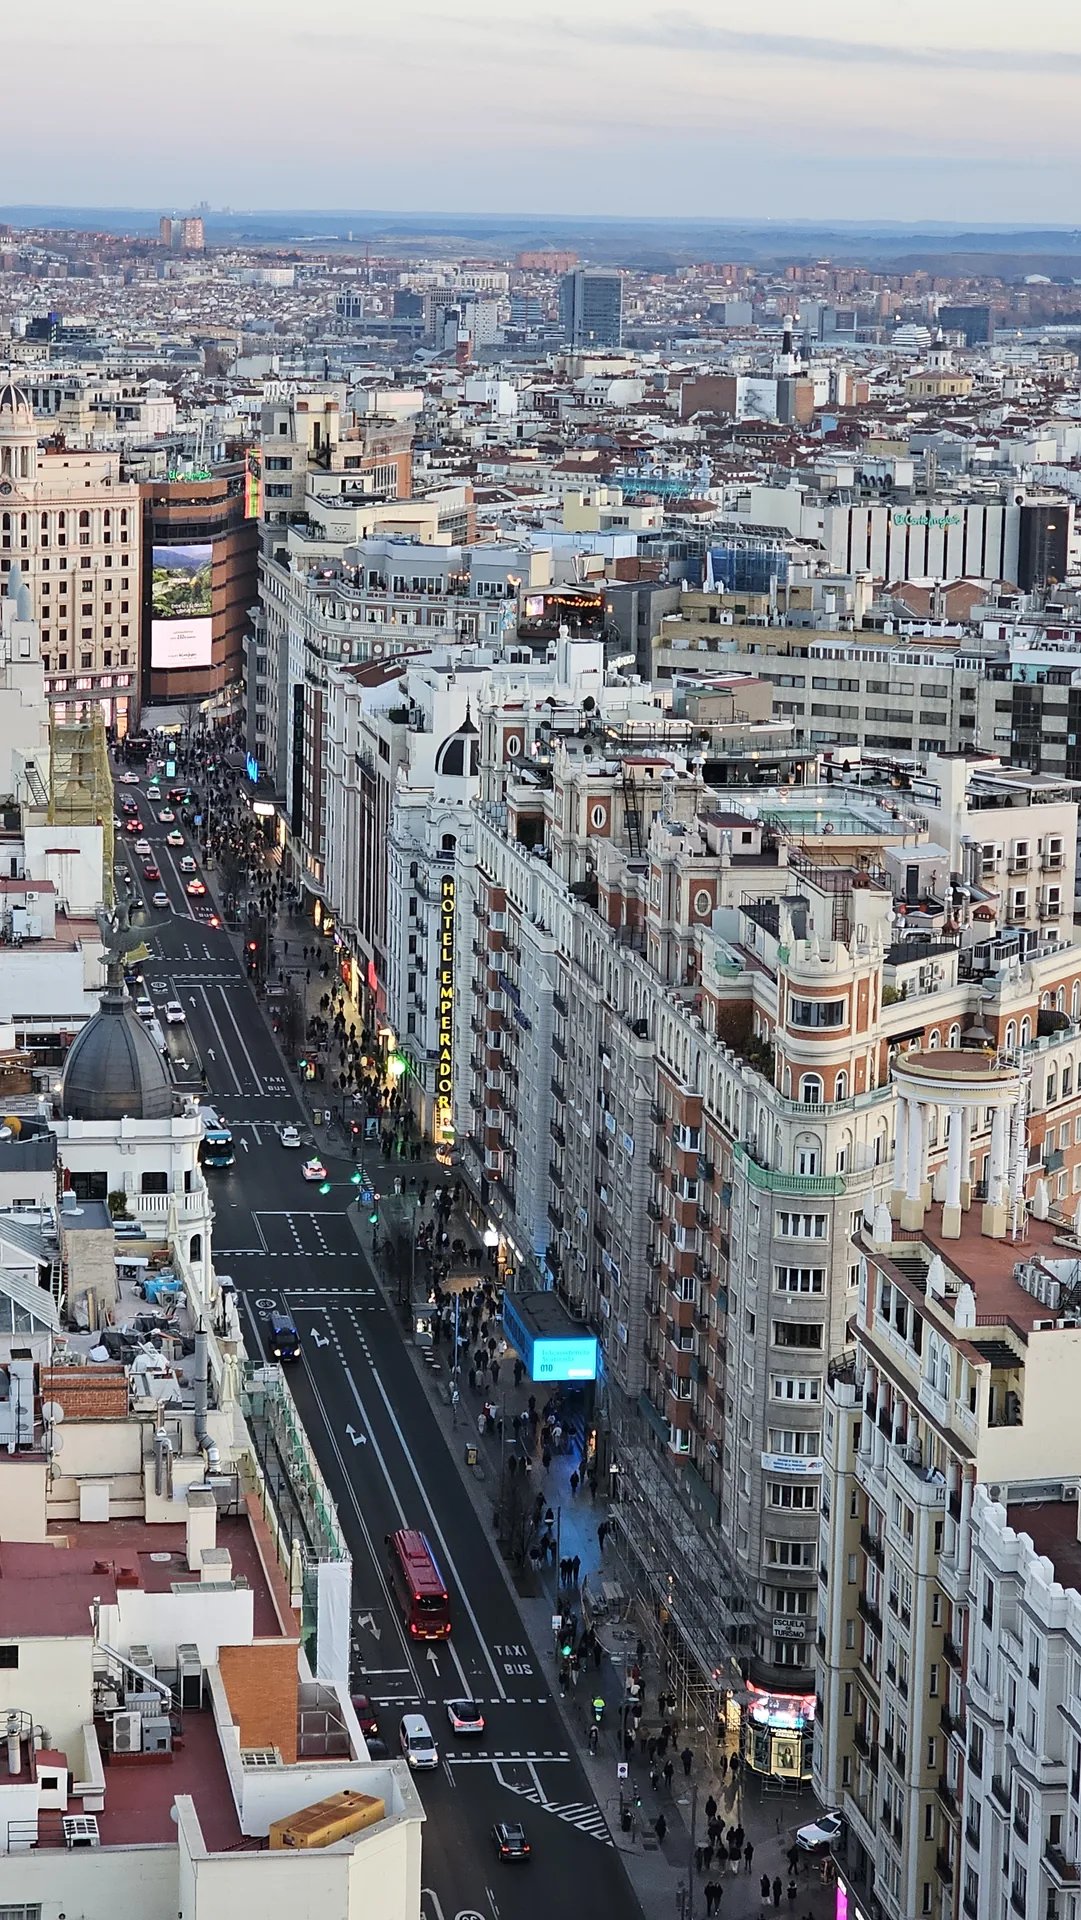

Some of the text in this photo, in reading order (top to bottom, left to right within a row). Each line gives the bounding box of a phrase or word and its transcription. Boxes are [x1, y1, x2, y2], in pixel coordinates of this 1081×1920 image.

[439, 883, 454, 1108] HOTEL EMPERADOR
[540, 1363, 553, 1372] 010
[773, 1619, 805, 1628] ESCUELA
[774, 1629, 804, 1638] TURISMO
[493, 1645, 527, 1656] TAXI
[503, 1663, 533, 1675] BUS
